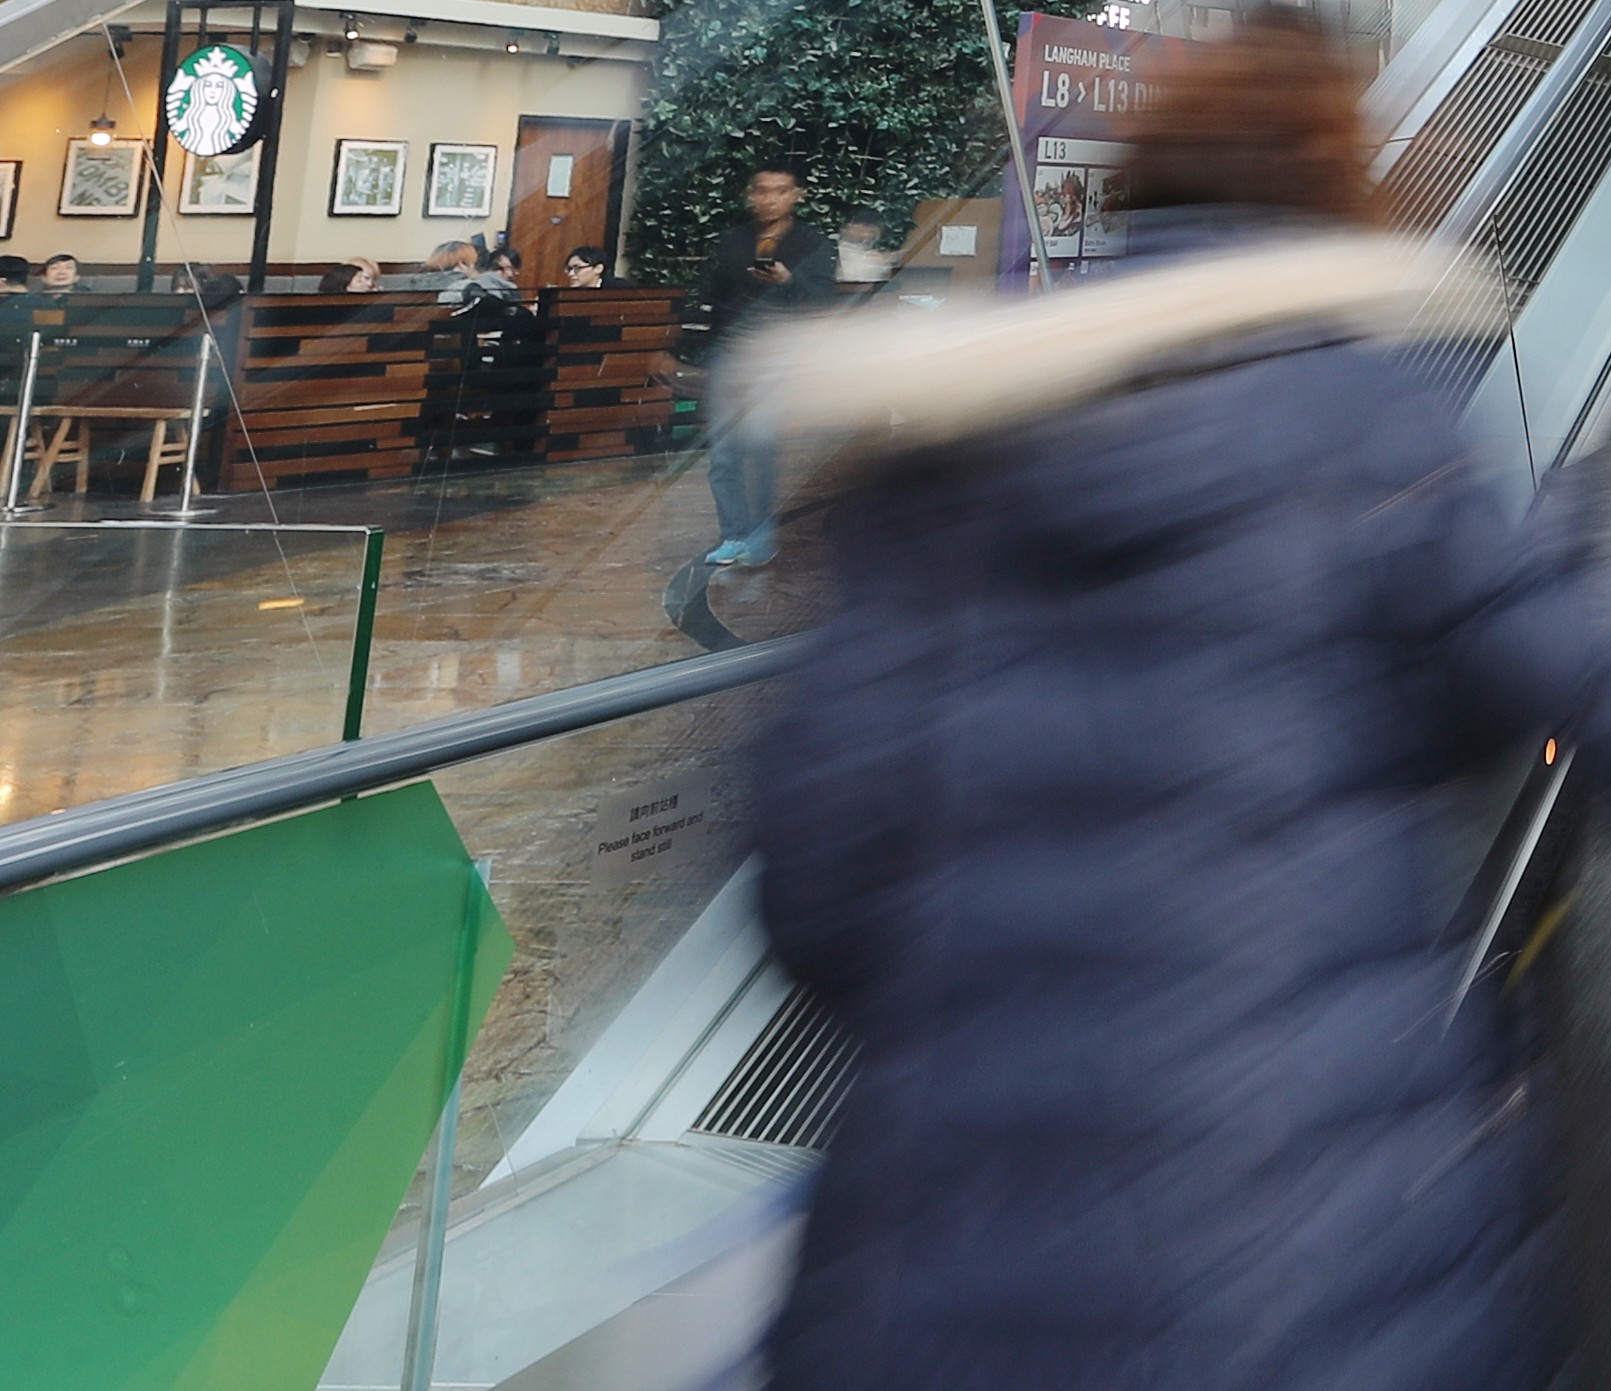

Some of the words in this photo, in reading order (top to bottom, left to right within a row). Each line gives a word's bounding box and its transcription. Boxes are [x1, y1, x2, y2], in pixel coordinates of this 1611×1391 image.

[1044, 44, 1097, 68] LANGHAM
[1099, 52, 1131, 73] PLACE
[1041, 70, 1070, 108] L8
[1093, 76, 1129, 114] L13
[1044, 140, 1067, 160] L13
[597, 836, 630, 856] Please
[630, 829, 651, 845] face
[652, 815, 686, 838] forward
[686, 810, 704, 827] and
[630, 843, 656, 863] stand
[657, 837, 673, 854] still
